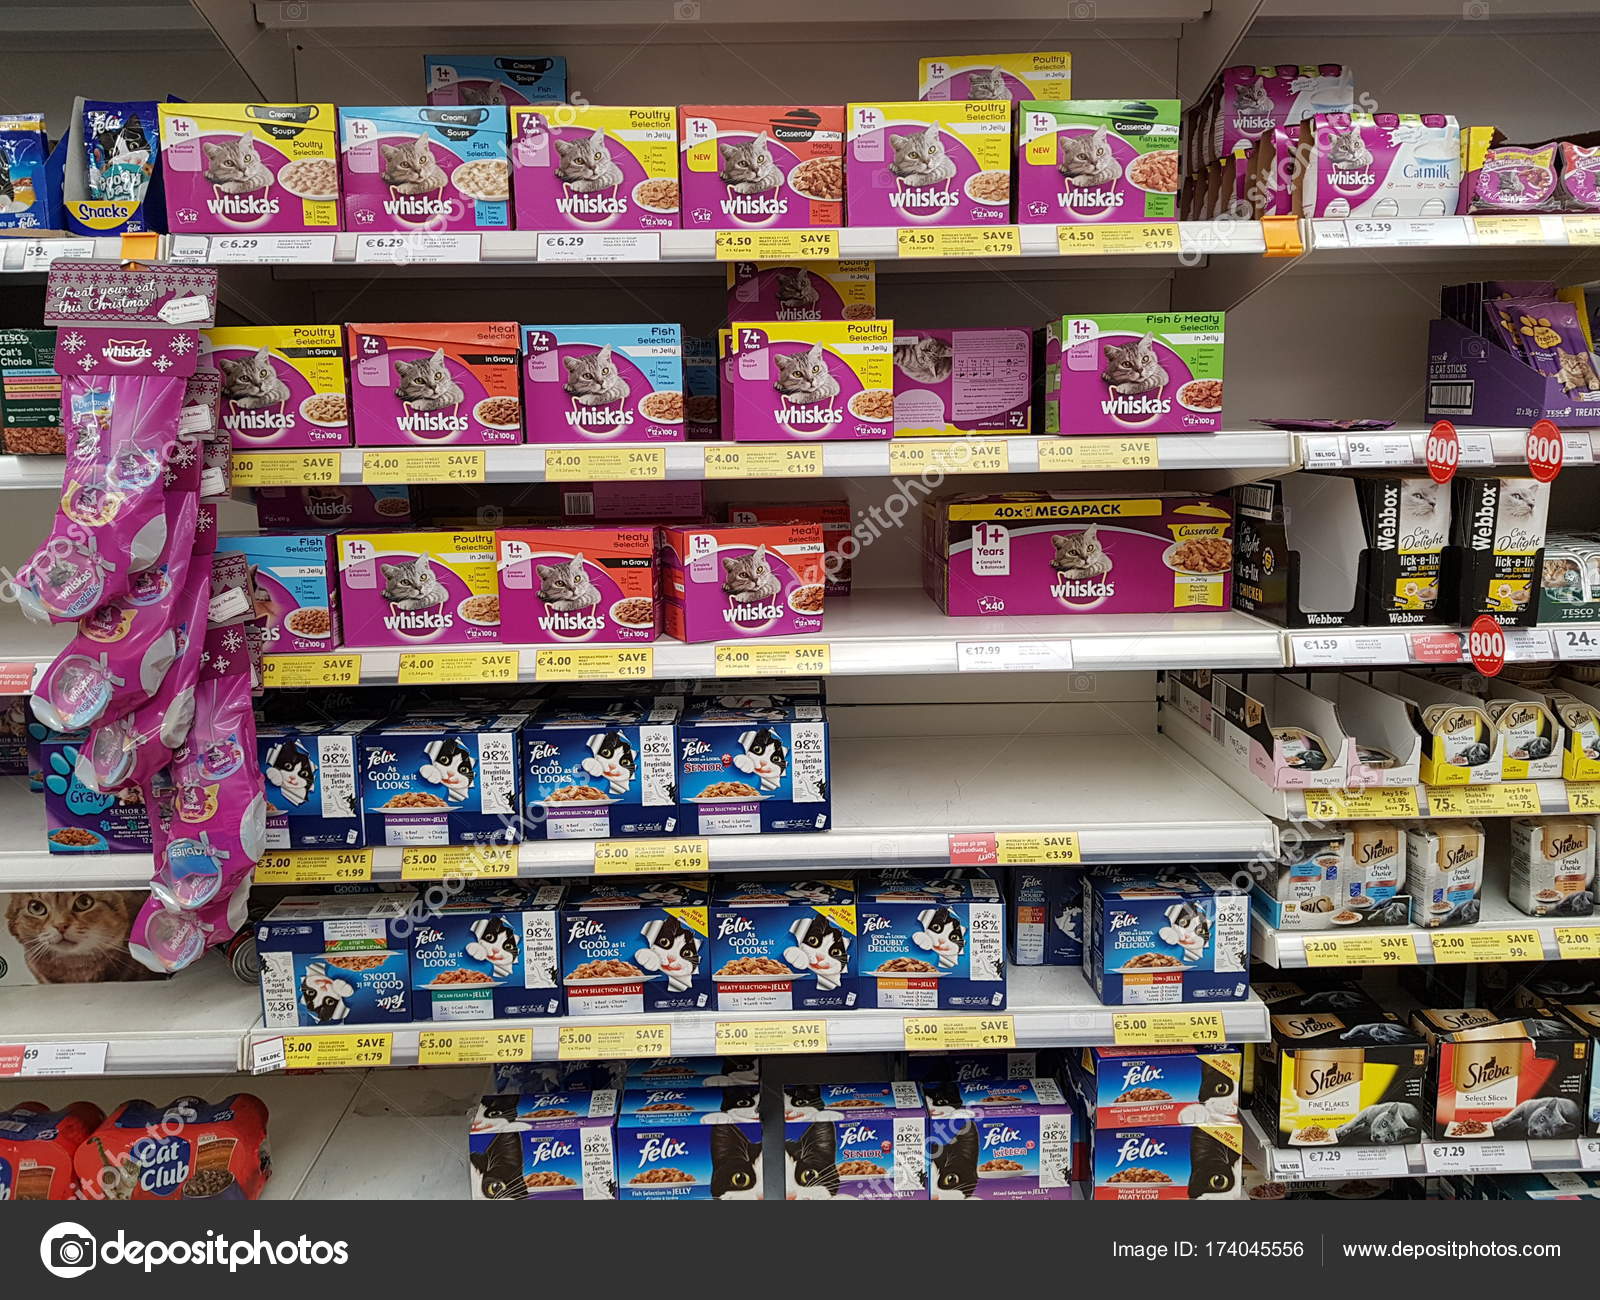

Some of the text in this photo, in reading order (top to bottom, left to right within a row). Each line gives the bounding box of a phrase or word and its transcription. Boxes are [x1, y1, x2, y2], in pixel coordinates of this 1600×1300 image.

[269, 111, 296, 120] Creamy
[630, 110, 670, 120] Poultry
[1233, 116, 1276, 129] whiskas
[272, 127, 296, 136] Soups
[775, 129, 812, 138] Casserole
[292, 140, 323, 150] Poultry
[1404, 164, 1450, 180] Catmilk
[1328, 172, 1375, 186] whiskas
[207, 195, 279, 214] whiskas
[1058, 191, 1124, 208] whiskas
[383, 199, 452, 215] whiskas
[721, 197, 788, 215] whiskas
[79, 204, 128, 220] Snacks
[1355, 223, 1391, 232] €3.39
[1060, 232, 1094, 240] €4.50
[1142, 229, 1173, 237] SAVE
[220, 239, 258, 249] €6.29
[56, 279, 156, 299] Treat your cat
[55, 294, 154, 313] this Christmas!
[1146, 314, 1219, 324] Fish Meaty
[294, 328, 335, 338] Poultry
[488, 324, 515, 333] Meat
[651, 328, 675, 336] Fish
[848, 324, 887, 334] Poultry
[531, 332, 549, 345] 7+
[1202, 334, 1219, 342] Jelly
[102, 348, 152, 357] whiskas
[315, 348, 337, 357] Gravy
[1, 358, 32, 366] Choice
[1435, 364, 1467, 373] CAT STICKS
[1102, 396, 1170, 415] whiskas
[224, 411, 295, 429] whiskas
[565, 407, 633, 425] whiskas
[775, 406, 843, 424] whiskas
[397, 413, 468, 431] whiskas
[1350, 442, 1370, 452] 99c
[1427, 437, 1457, 465] 800
[547, 456, 580, 466] €4.00
[628, 453, 658, 462] SAVE
[630, 467, 657, 475] €1.19
[994, 504, 1120, 517] 40x MEGAPACK
[1377, 486, 1398, 551] Webbox
[1472, 484, 1496, 551] Webbox
[975, 523, 1003, 545] 1+
[1178, 526, 1219, 537] Casserole
[1414, 527, 1429, 536] Cats
[300, 538, 322, 546] Fish
[453, 535, 492, 544] Poultry
[617, 533, 649, 542] Meaty
[1401, 534, 1444, 551] Delight
[977, 548, 1004, 556] Years
[629, 559, 649, 568] Gravy
[1401, 555, 1439, 566] lick-e-lix
[1050, 581, 1115, 598] whiskas
[985, 601, 1004, 611] x40
[1561, 608, 1594, 616] TESCO
[384, 611, 452, 629] whiskas
[1307, 614, 1343, 625] Webbox
[1413, 636, 1431, 644] Sorry
[1566, 632, 1598, 646] 24c
[1304, 640, 1338, 649] €1.59
[1471, 632, 1502, 657] 800
[795, 649, 824, 658] SAVE
[966, 646, 1000, 655] €17.99
[400, 660, 434, 669] €4.00
[797, 662, 823, 671] €1.19
[1511, 711, 1535, 726] Sheba
[1448, 717, 1472, 731] Sheba
[683, 742, 711, 759] felix
[367, 752, 397, 769] felix
[685, 762, 724, 773] SENIOR
[368, 772, 400, 781] GOOD
[70, 791, 110, 805] Gravy
[1433, 799, 1455, 809] 75c
[1044, 837, 1072, 846] SAVE
[1361, 843, 1393, 863] Sheba
[1551, 840, 1583, 858] Sheba
[337, 855, 366, 864] SAVE
[1046, 851, 1072, 859] €3.99
[257, 858, 290, 868] €5.00
[337, 869, 363, 877] €1.99
[680, 908, 705, 926] MULTIPACK
[691, 908, 701, 918] NEW
[569, 921, 605, 941] felix
[1305, 943, 1336, 952] €2.00
[1381, 938, 1409, 947] SAVE
[868, 944, 909, 953] DELICIOUS
[416, 949, 447, 959] GOOD
[1384, 952, 1401, 961] 99c
[622, 984, 640, 993] JELLY
[636, 1030, 664, 1038] SAVE
[420, 1039, 452, 1048] €5.00
[637, 1044, 662, 1052] €1.79
[1122, 1066, 1162, 1090] felix
[1463, 1062, 1510, 1089] Sheba
[1306, 1068, 1353, 1095] Sheba
[141, 1142, 180, 1168] Cat
[532, 1142, 572, 1167] felix
[638, 1139, 686, 1169] felix
[993, 1147, 1028, 1157] kitten
[1310, 1152, 1341, 1162] €7.29
[140, 1160, 189, 1190] Club
